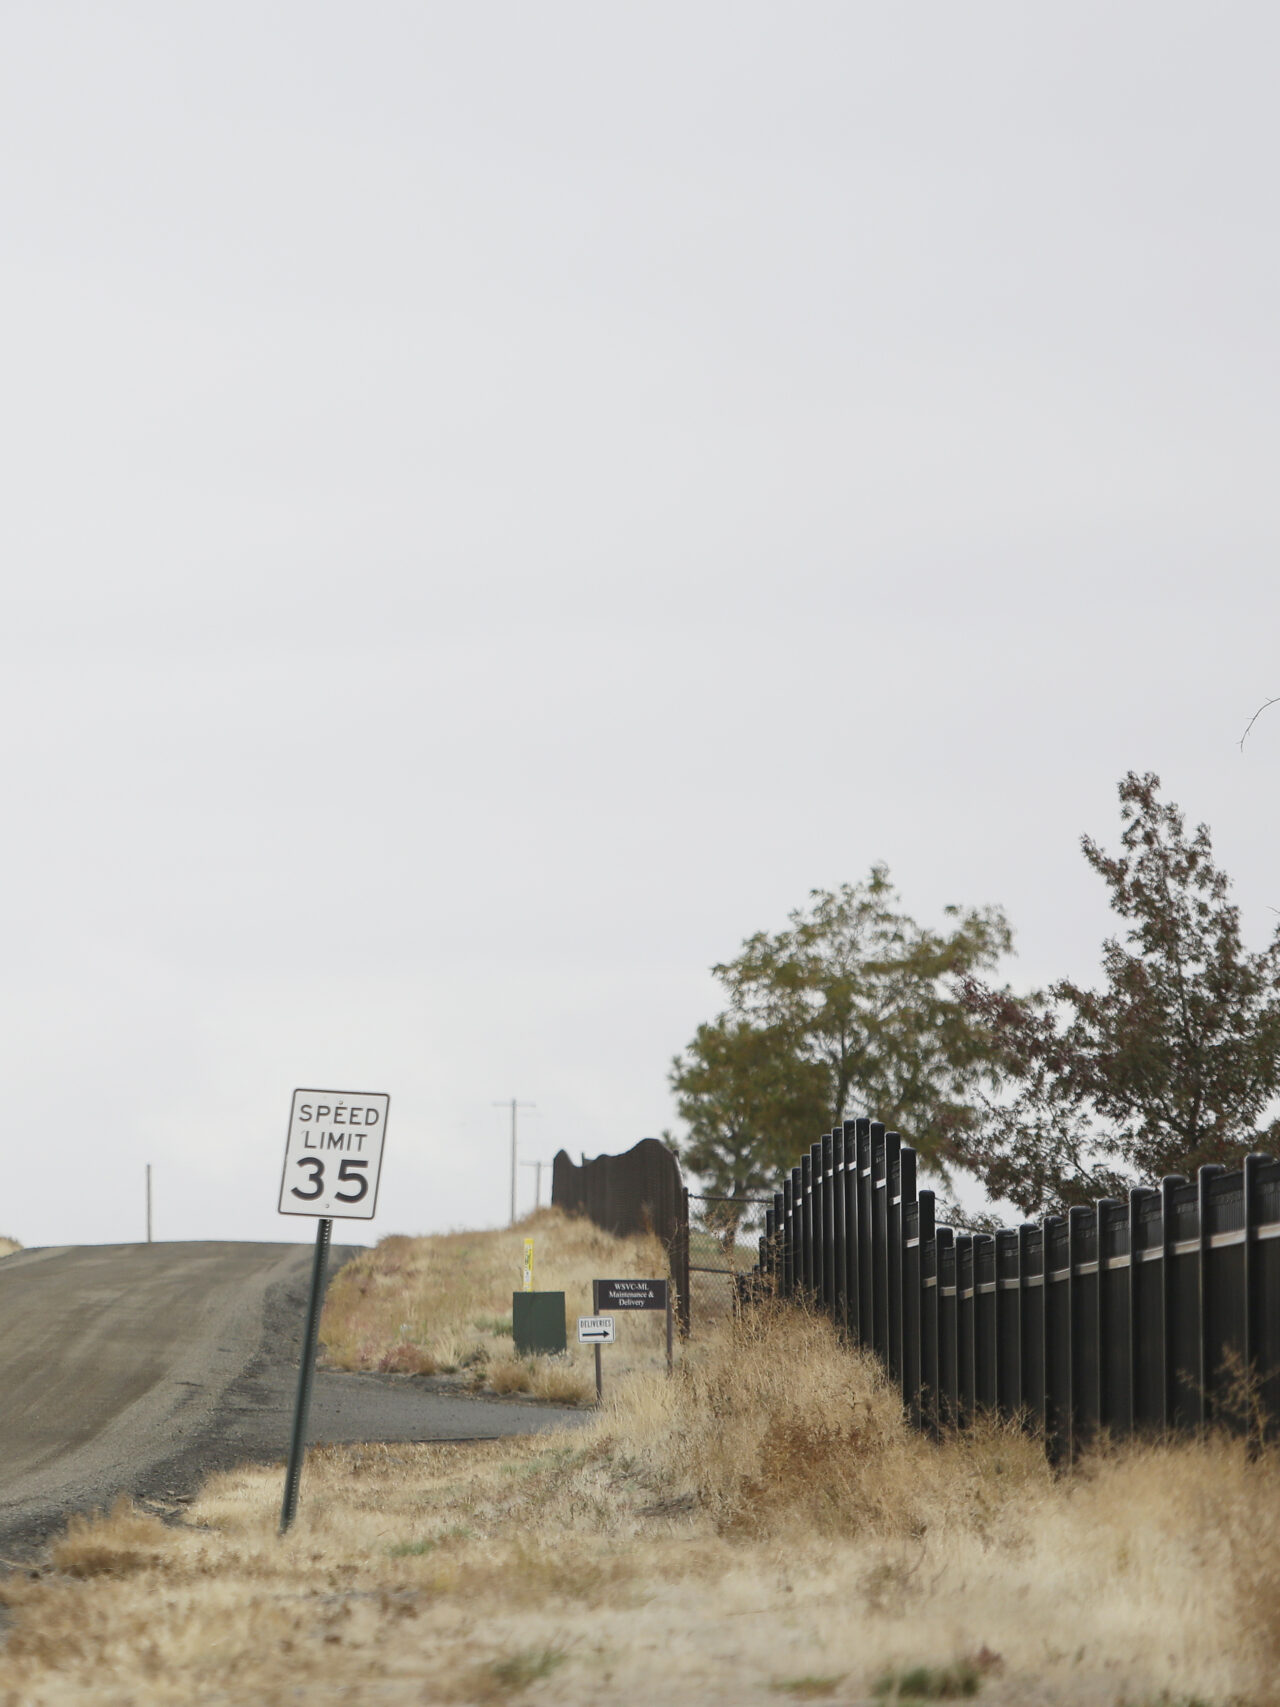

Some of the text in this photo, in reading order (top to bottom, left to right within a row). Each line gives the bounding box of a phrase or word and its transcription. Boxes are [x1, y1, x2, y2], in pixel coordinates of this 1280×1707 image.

[299, 1104, 379, 1126] SPEED
[304, 1131, 368, 1152] LIMIT
[291, 1157, 369, 1204] 35
[619, 1299, 645, 1307] Delivery
[580, 1319, 611, 1328] DELIVERIES
